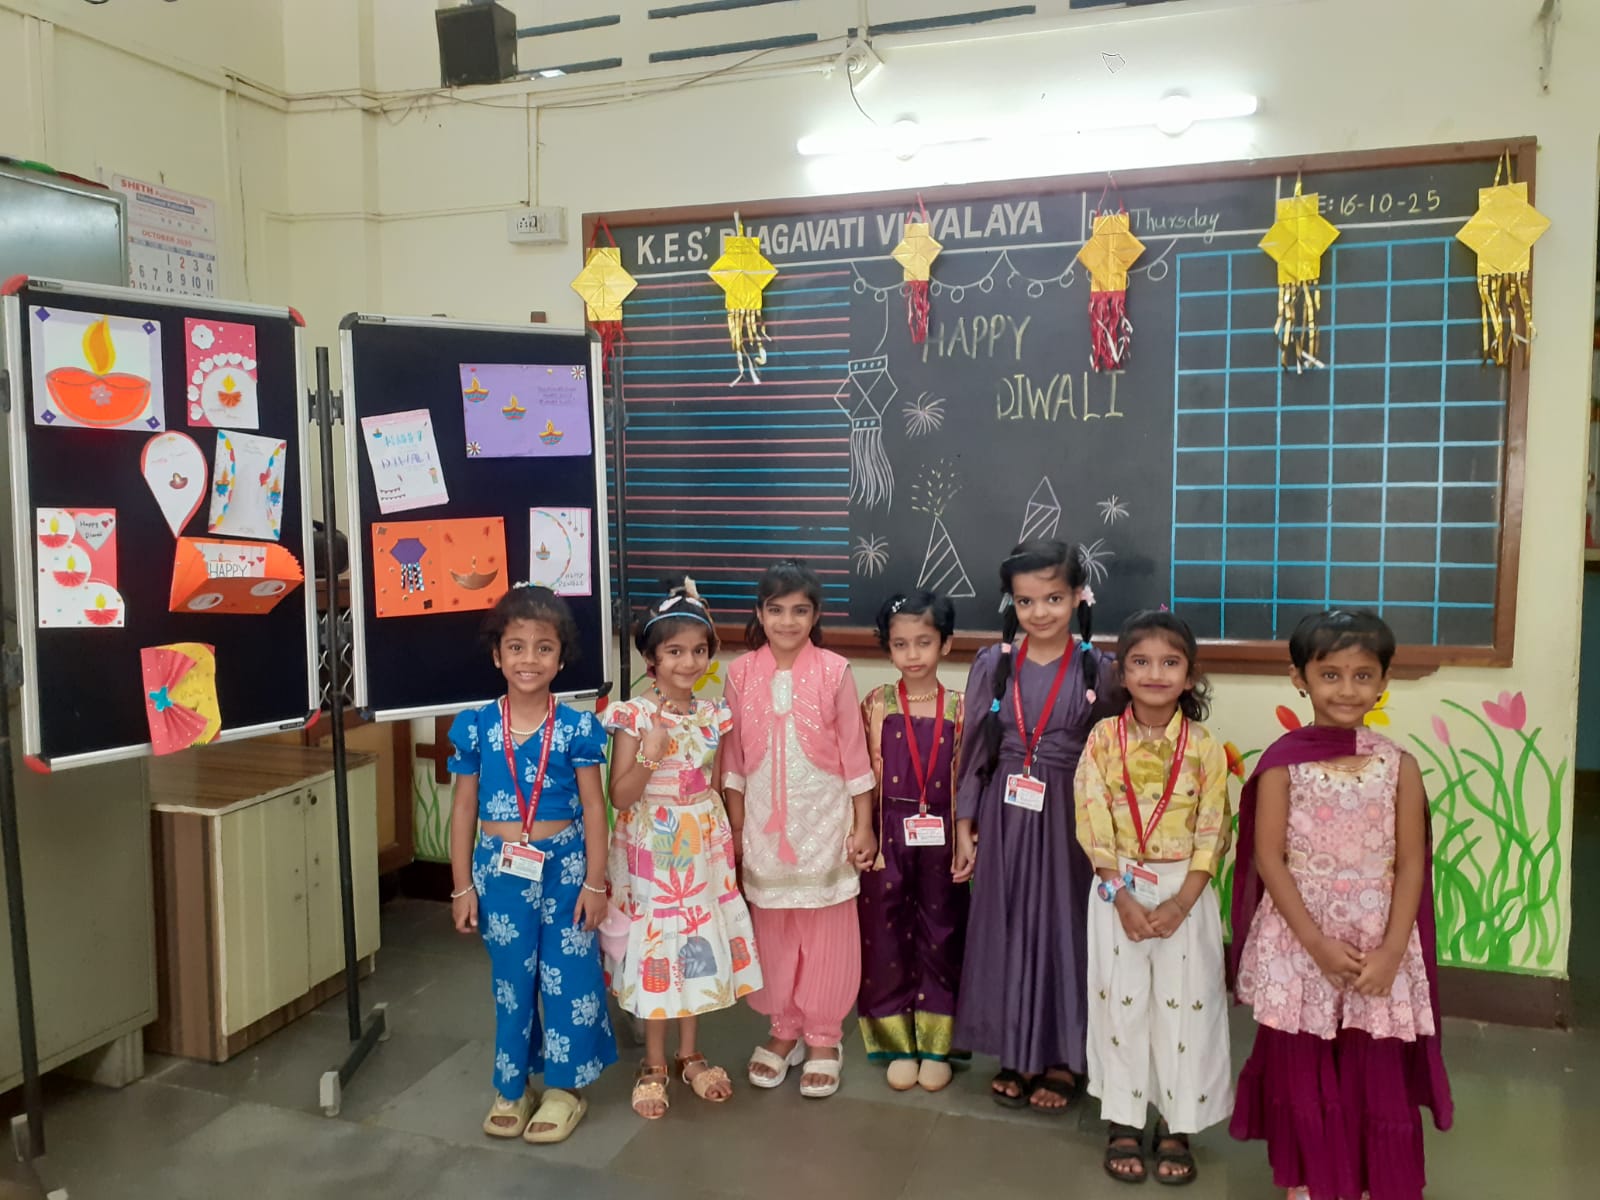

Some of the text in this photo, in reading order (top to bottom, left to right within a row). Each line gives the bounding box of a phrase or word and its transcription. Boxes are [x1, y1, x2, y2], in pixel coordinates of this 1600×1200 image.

[121, 179, 153, 195] SHETH
[719, 216, 865, 256] AGAVATI
[1130, 207, 1220, 244] Thursday
[138, 264, 145, 278] 6
[152, 267, 158, 281] 7
[166, 270, 173, 284] 8
[180, 273, 186, 286] 9
[191, 275, 201, 289] 10
[206, 279, 214, 291] 11
[179, 256, 185, 269] 2
[193, 259, 199, 272] 3
[206, 262, 213, 274] 4
[922, 314, 1031, 363] HAPPY
[996, 370, 1127, 422] DIWALI
[209, 562, 248, 577] HAPPY
